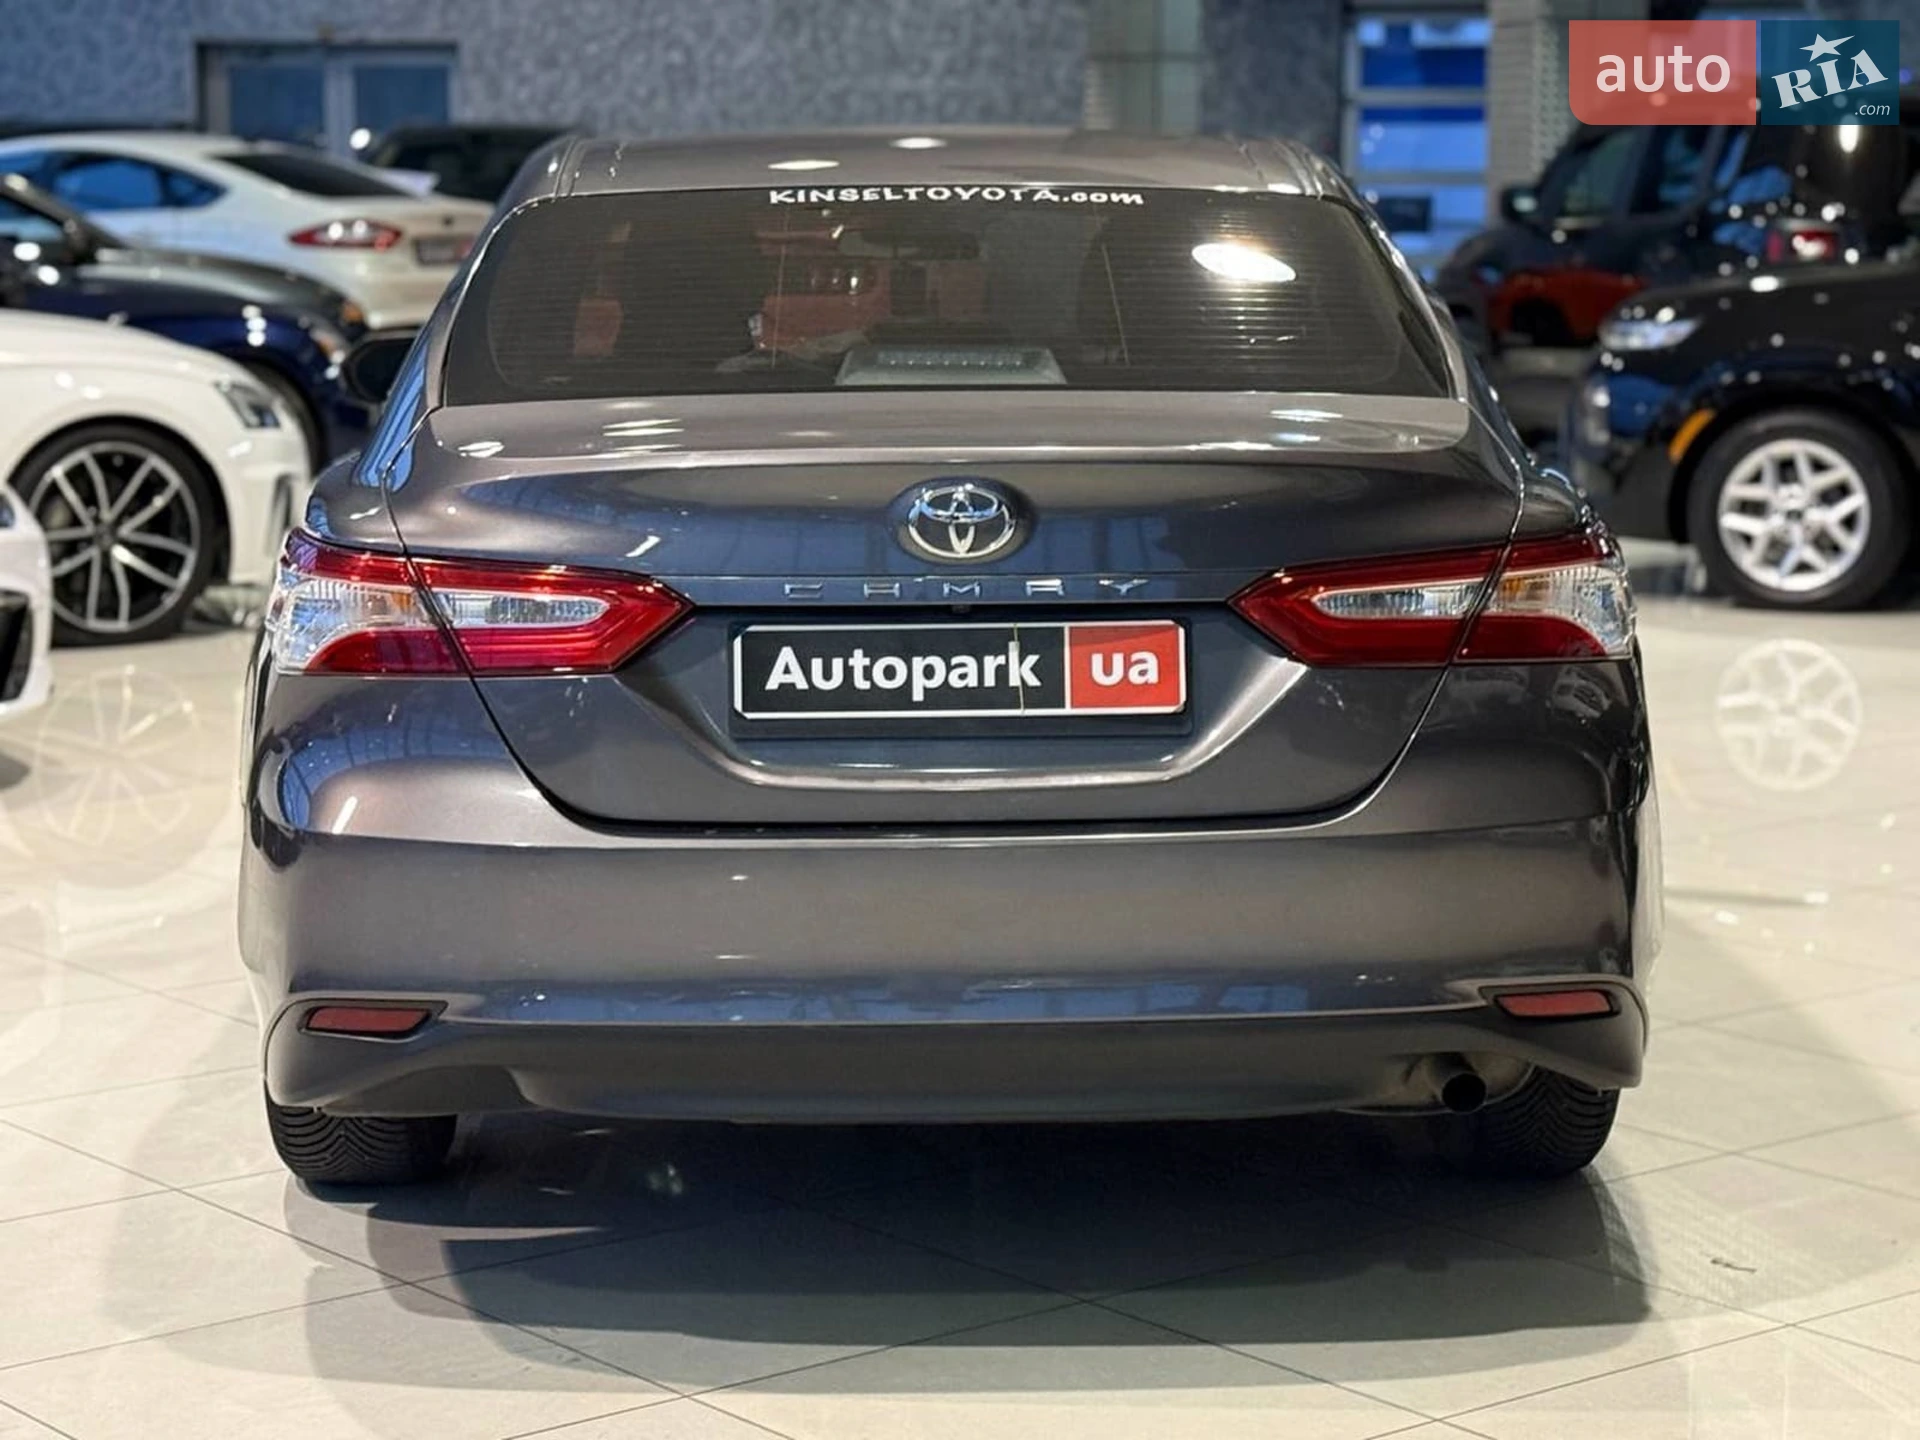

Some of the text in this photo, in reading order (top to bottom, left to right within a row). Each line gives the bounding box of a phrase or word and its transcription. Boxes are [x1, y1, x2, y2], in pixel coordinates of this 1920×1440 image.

[768, 186, 1144, 205] KINSELTOYOTA.com
[784, 578, 1149, 599] CAMRY
[764, 640, 1160, 702] Autopark ua
